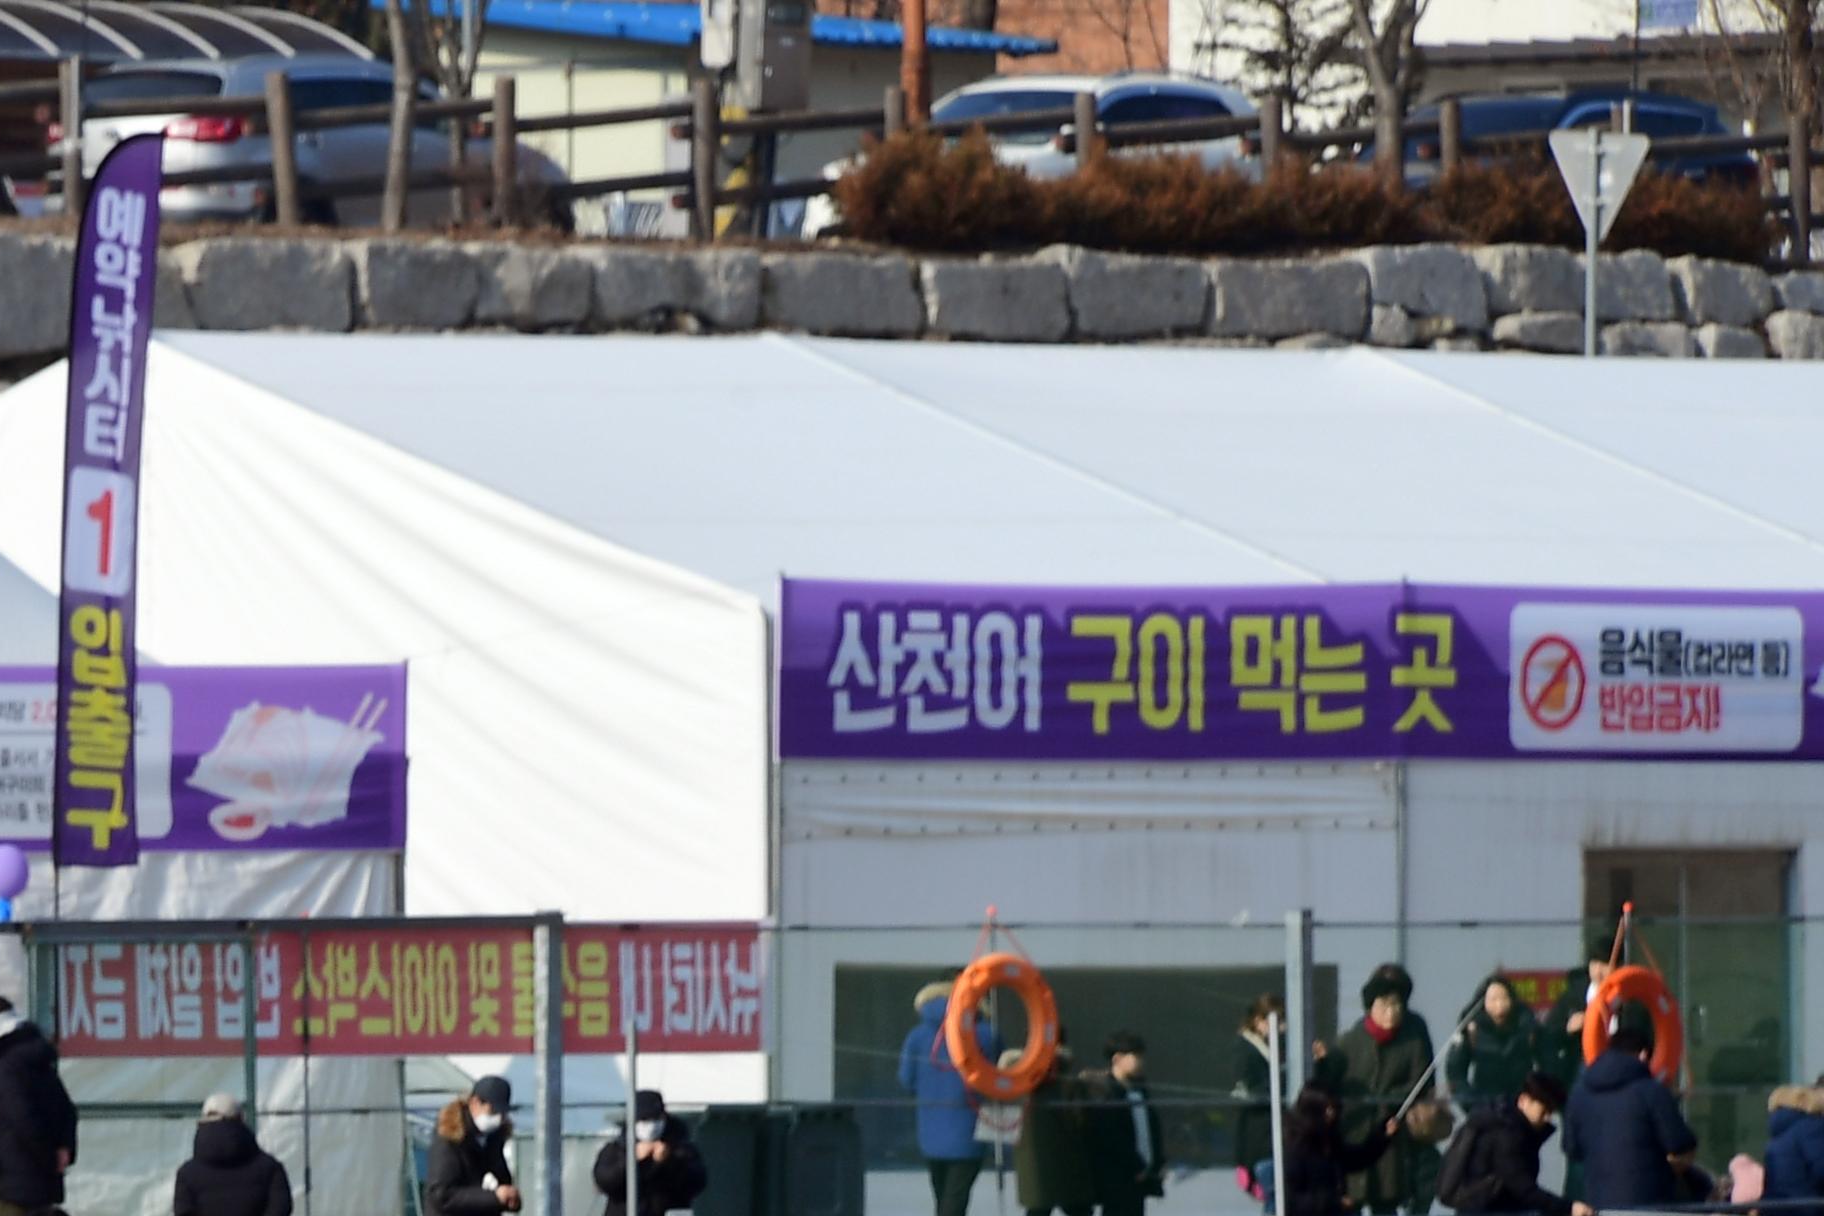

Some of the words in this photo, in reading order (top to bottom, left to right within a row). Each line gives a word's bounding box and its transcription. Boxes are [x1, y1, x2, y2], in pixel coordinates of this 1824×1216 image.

[84, 187, 146, 462] 예약낚시터
[87, 489, 112, 577] 1
[66, 605, 131, 850] 입출구
[828, 611, 1044, 735] 산천어
[1067, 611, 1204, 735] 구이
[1229, 612, 1367, 735] 먹는
[1391, 613, 1458, 735] 곳
[1598, 683, 1722, 733] 반입금지!
